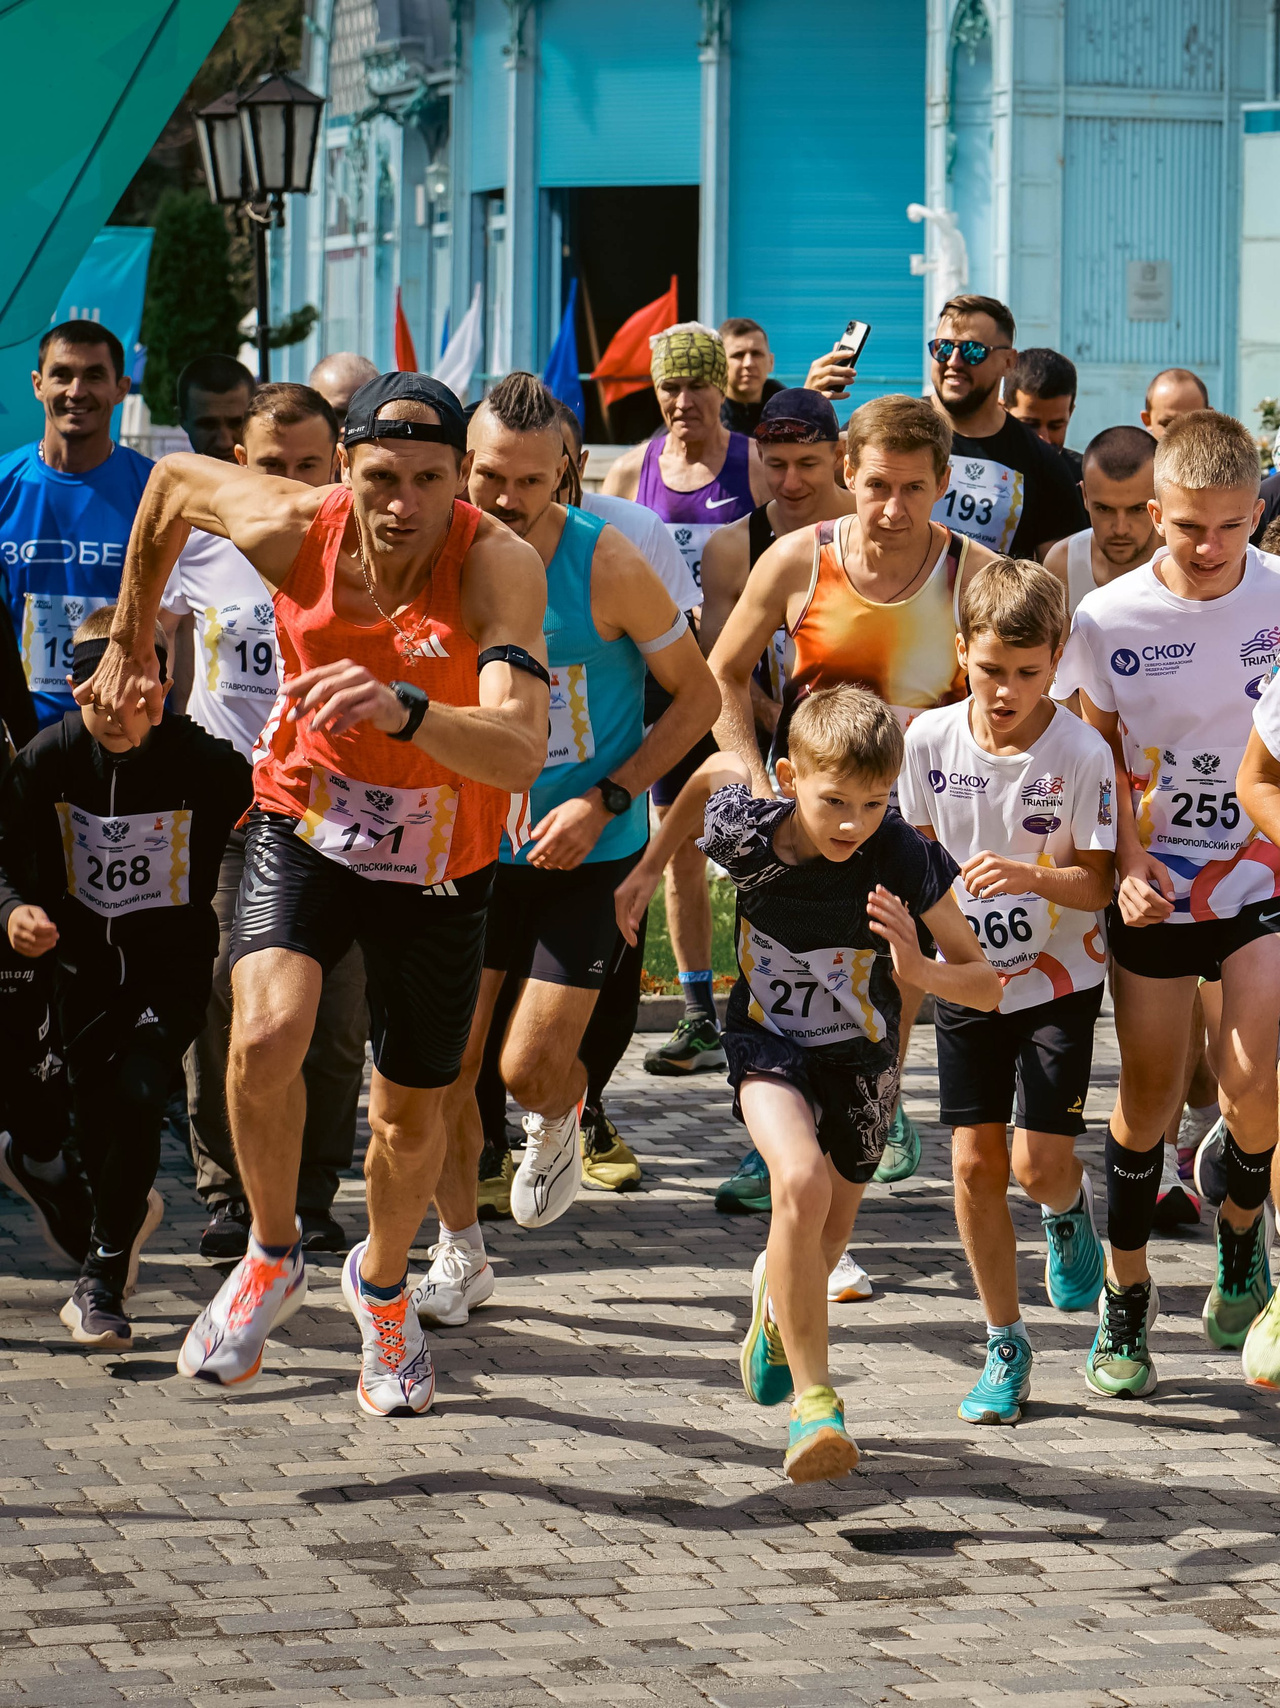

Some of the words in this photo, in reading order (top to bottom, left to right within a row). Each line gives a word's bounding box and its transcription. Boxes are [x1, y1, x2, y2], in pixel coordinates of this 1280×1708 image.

[944, 489, 994, 526] 193
[44, 636, 75, 669] 19
[235, 639, 277, 677] 19
[1141, 642, 1197, 661] СКФУ
[1241, 654, 1277, 668] TRIAT
[34, 676, 72, 686] СТАВРОПО
[220, 680, 278, 696] СТАВРОПОЛЬСКИ
[548, 747, 570, 759] КРАЙ
[949, 772, 991, 789] СКФУ
[1021, 798, 1064, 808] TRIATHLN
[1171, 792, 1241, 831] 255
[1156, 834, 1229, 851] СТАВРОПОЛЬСКИЙ
[87, 855, 151, 892] 268
[347, 862, 393, 874] ПОЛЬСКИЙ
[394, 863, 418, 875] КРАЙ
[141, 890, 162, 902] КРАЙ
[989, 952, 1027, 968] ОЛЬСКИЙ
[780, 1022, 839, 1039] РОПОЛЬСКИЙ
